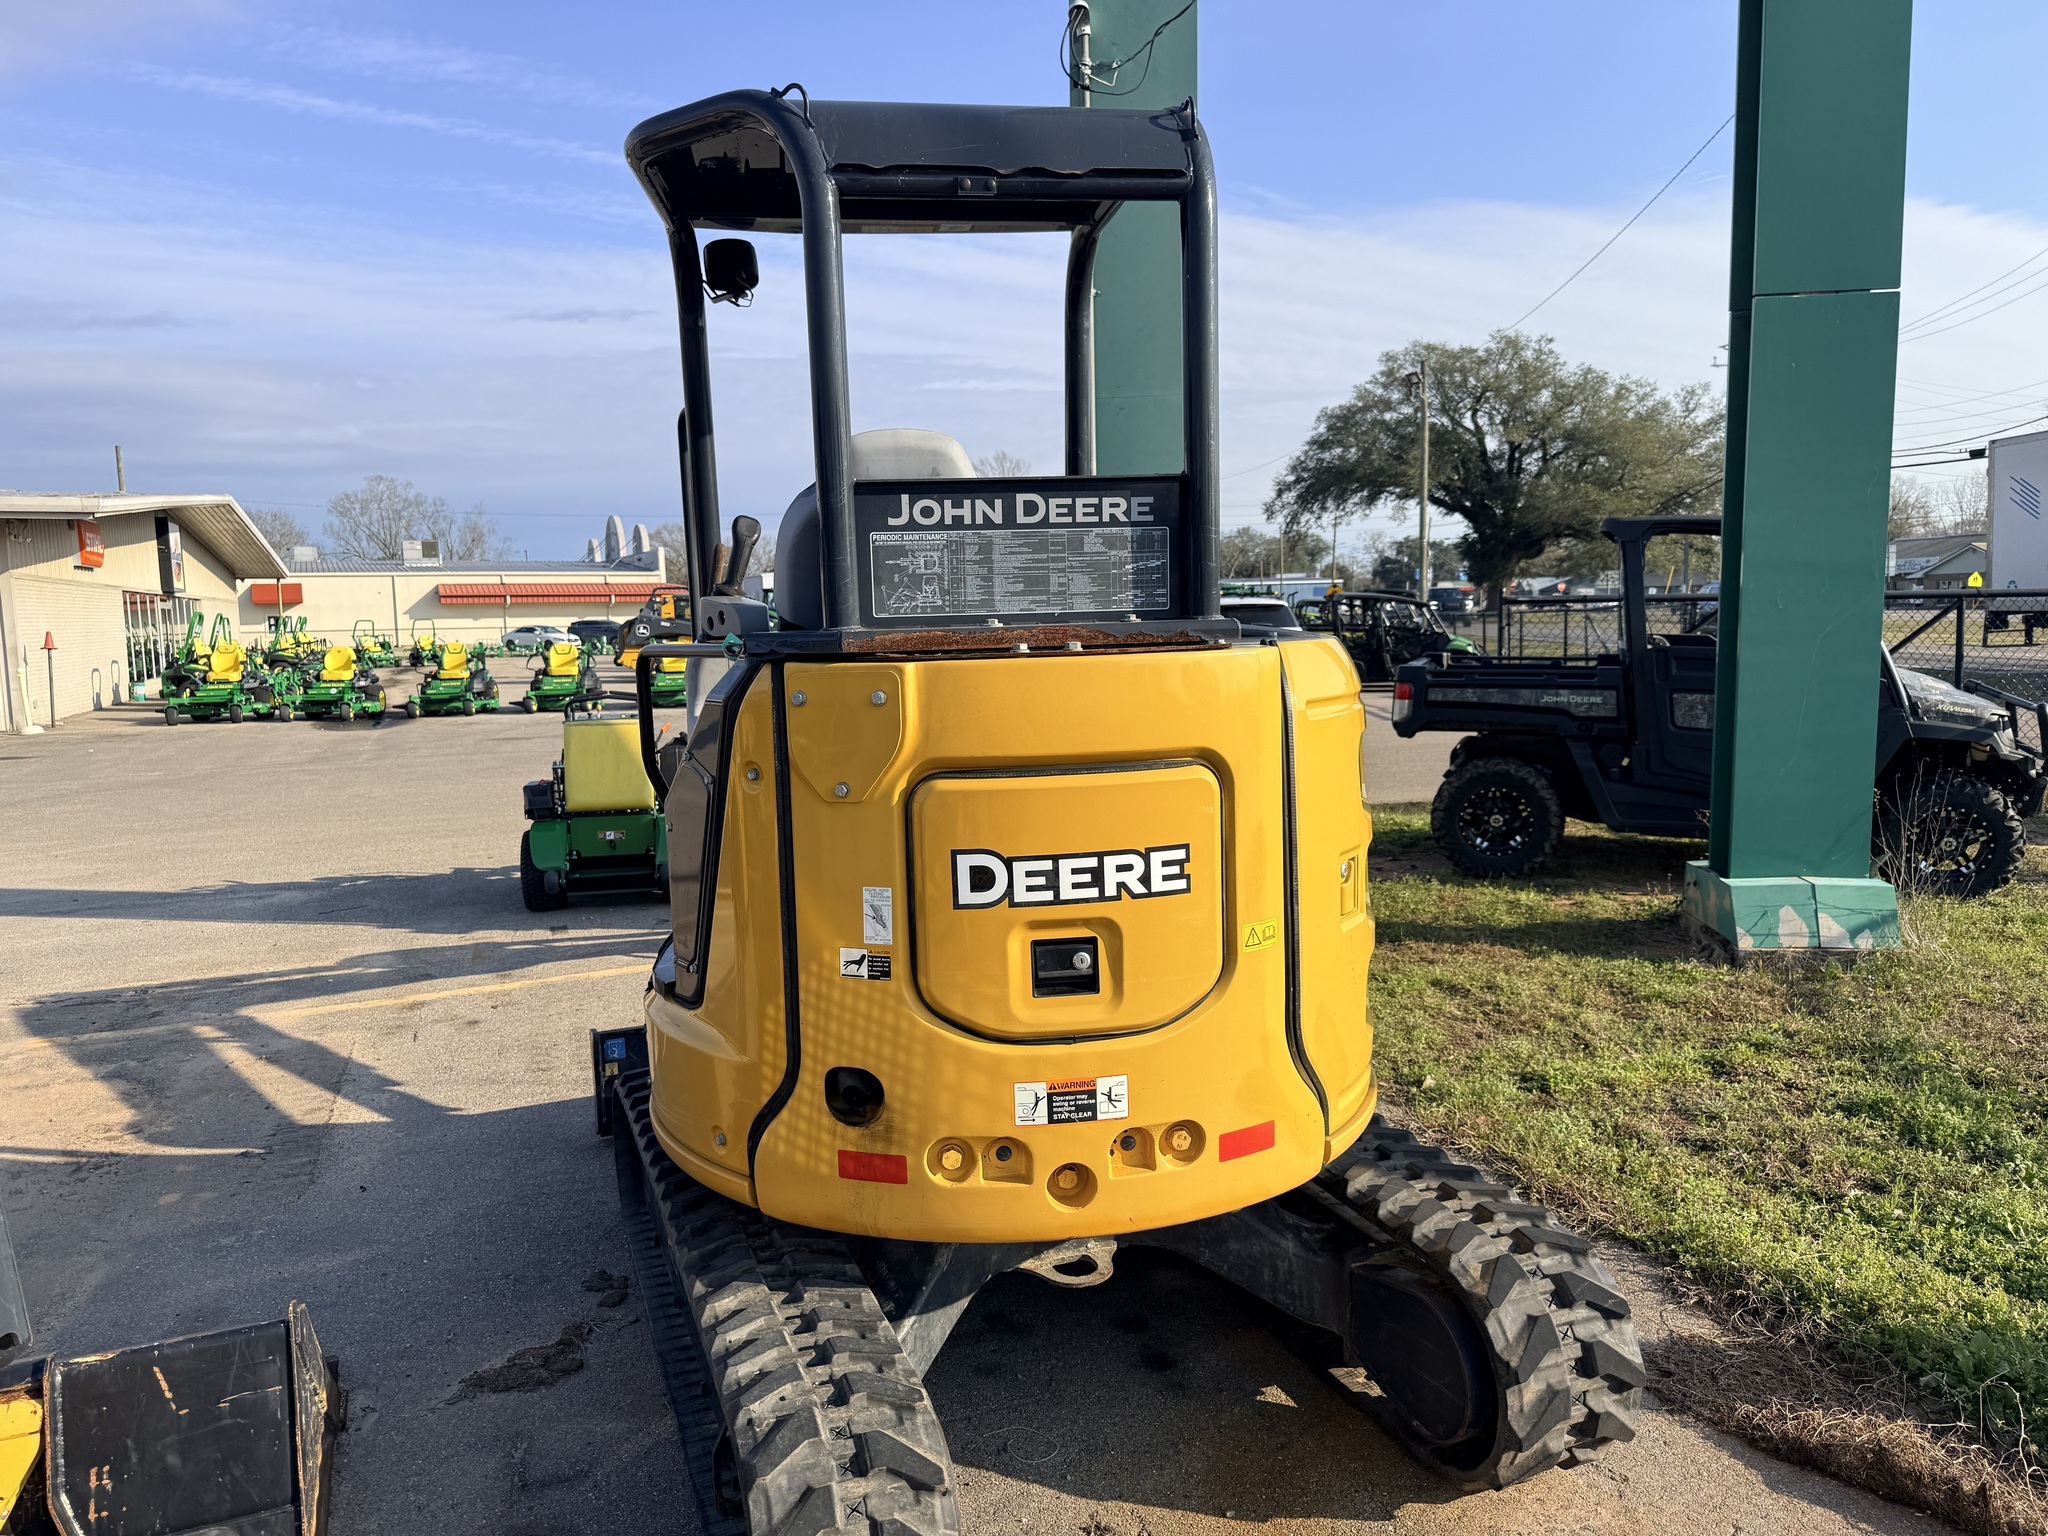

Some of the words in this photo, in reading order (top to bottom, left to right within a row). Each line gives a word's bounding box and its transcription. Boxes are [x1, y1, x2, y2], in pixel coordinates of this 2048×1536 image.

[887, 493, 1003, 526] JOHN
[1016, 492, 1154, 524] DEERE
[903, 533, 948, 541] MAINTENANCE
[85, 532, 104, 554] STIHL
[1541, 695, 1568, 703] JOHN
[1570, 695, 1603, 704] DEERE
[952, 845, 1190, 908] DEERE
[1057, 1080, 1096, 1090] WARNING
[1070, 1111, 1092, 1119] CLEAR
